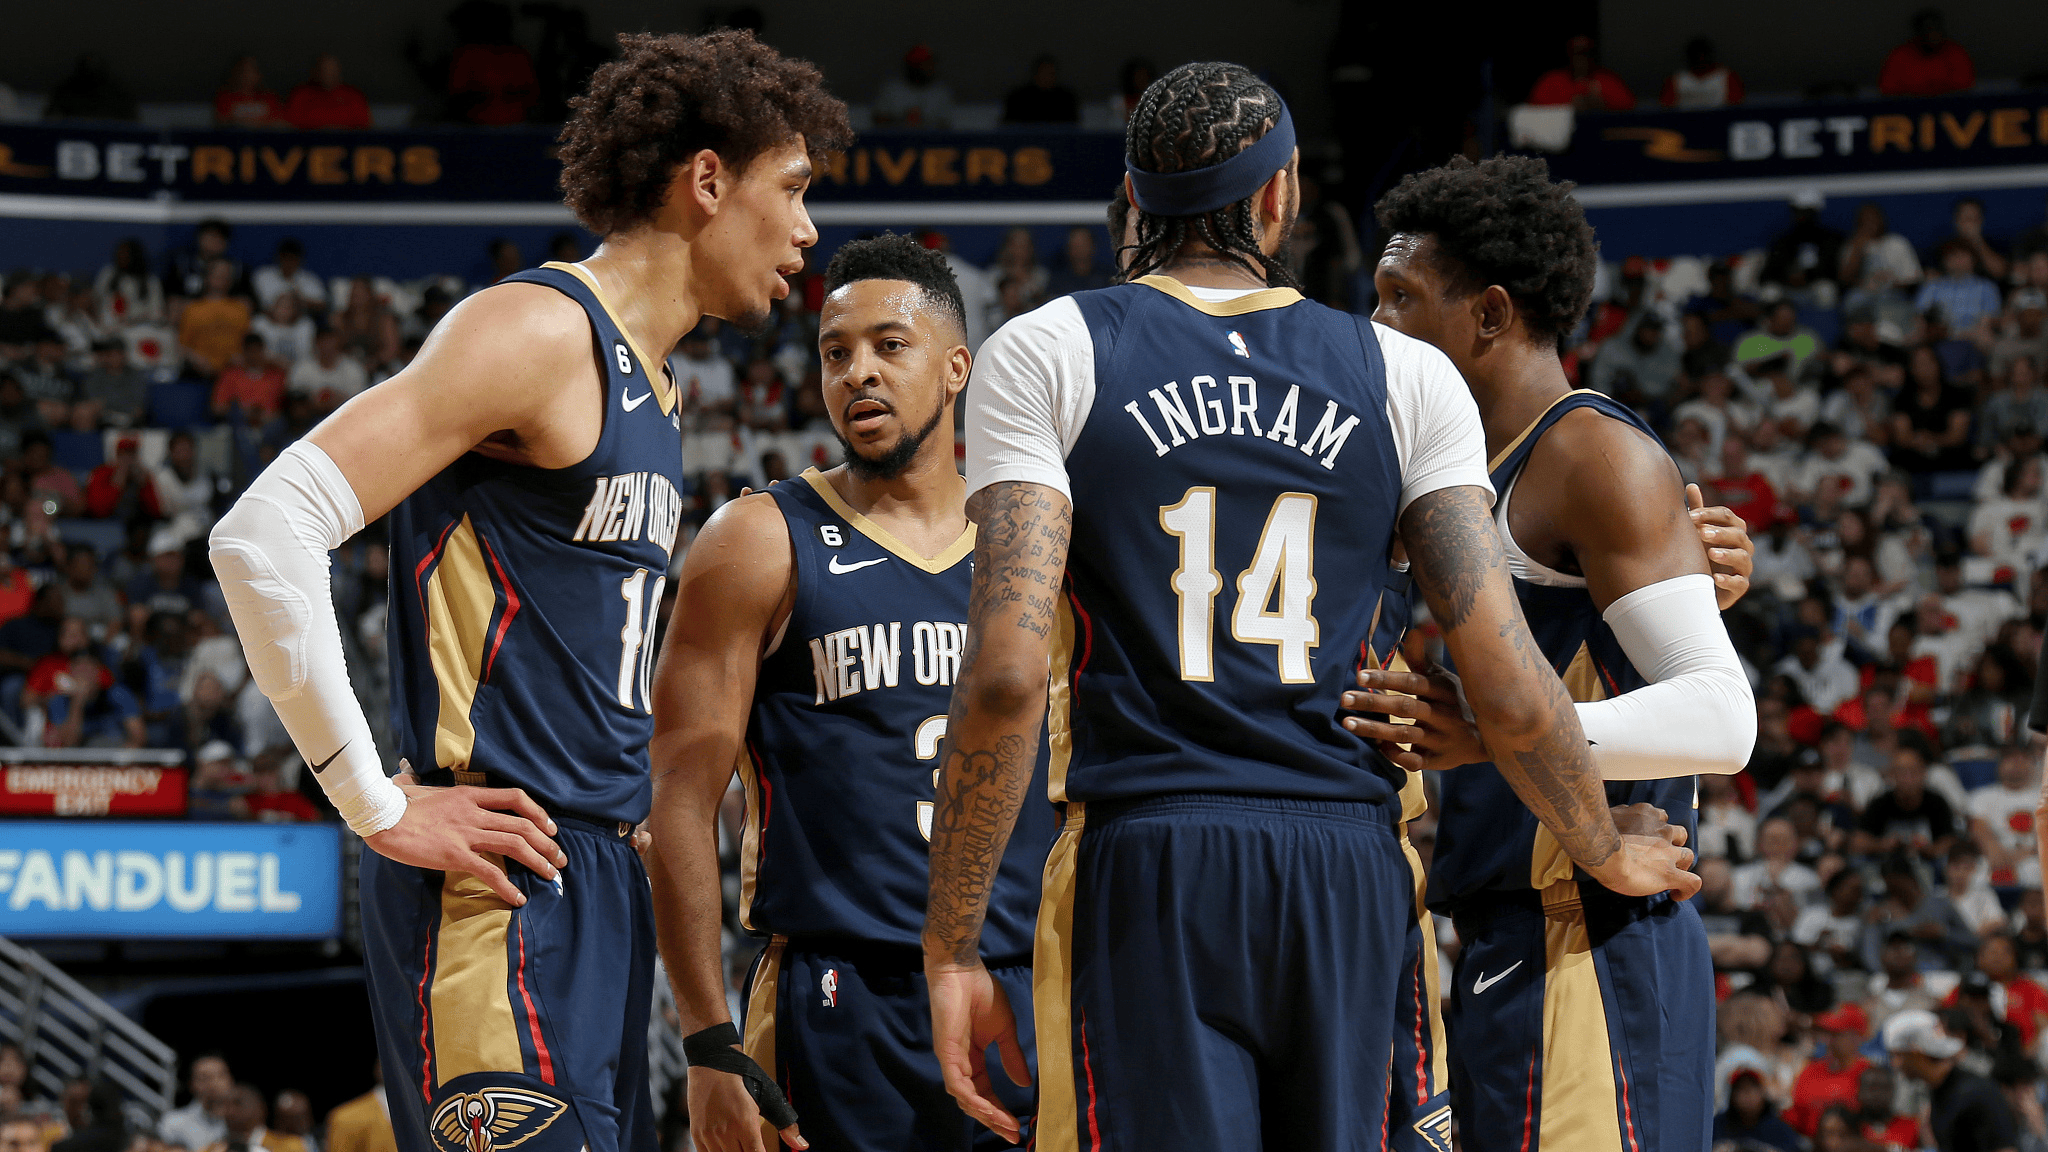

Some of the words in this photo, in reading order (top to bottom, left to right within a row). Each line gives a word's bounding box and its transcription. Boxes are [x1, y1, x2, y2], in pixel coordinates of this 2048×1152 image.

[1728, 107, 2048, 161] BETRIVE
[57, 140, 443, 185] BETRIVERS
[615, 343, 632, 374] 6
[1124, 375, 1361, 470] INGRAM
[573, 472, 648, 542] NEW
[1012, 489, 1051, 511] The
[819, 524, 844, 547] 6
[1021, 515, 1041, 538] of
[1031, 539, 1044, 556] is
[1042, 547, 1064, 568] far
[1009, 565, 1047, 585] worse
[1159, 486, 1320, 684] 14
[1001, 585, 1023, 602] the
[809, 621, 902, 706] NEW
[6, 765, 163, 794] EMERGENCY
[54, 793, 112, 817] EXIT
